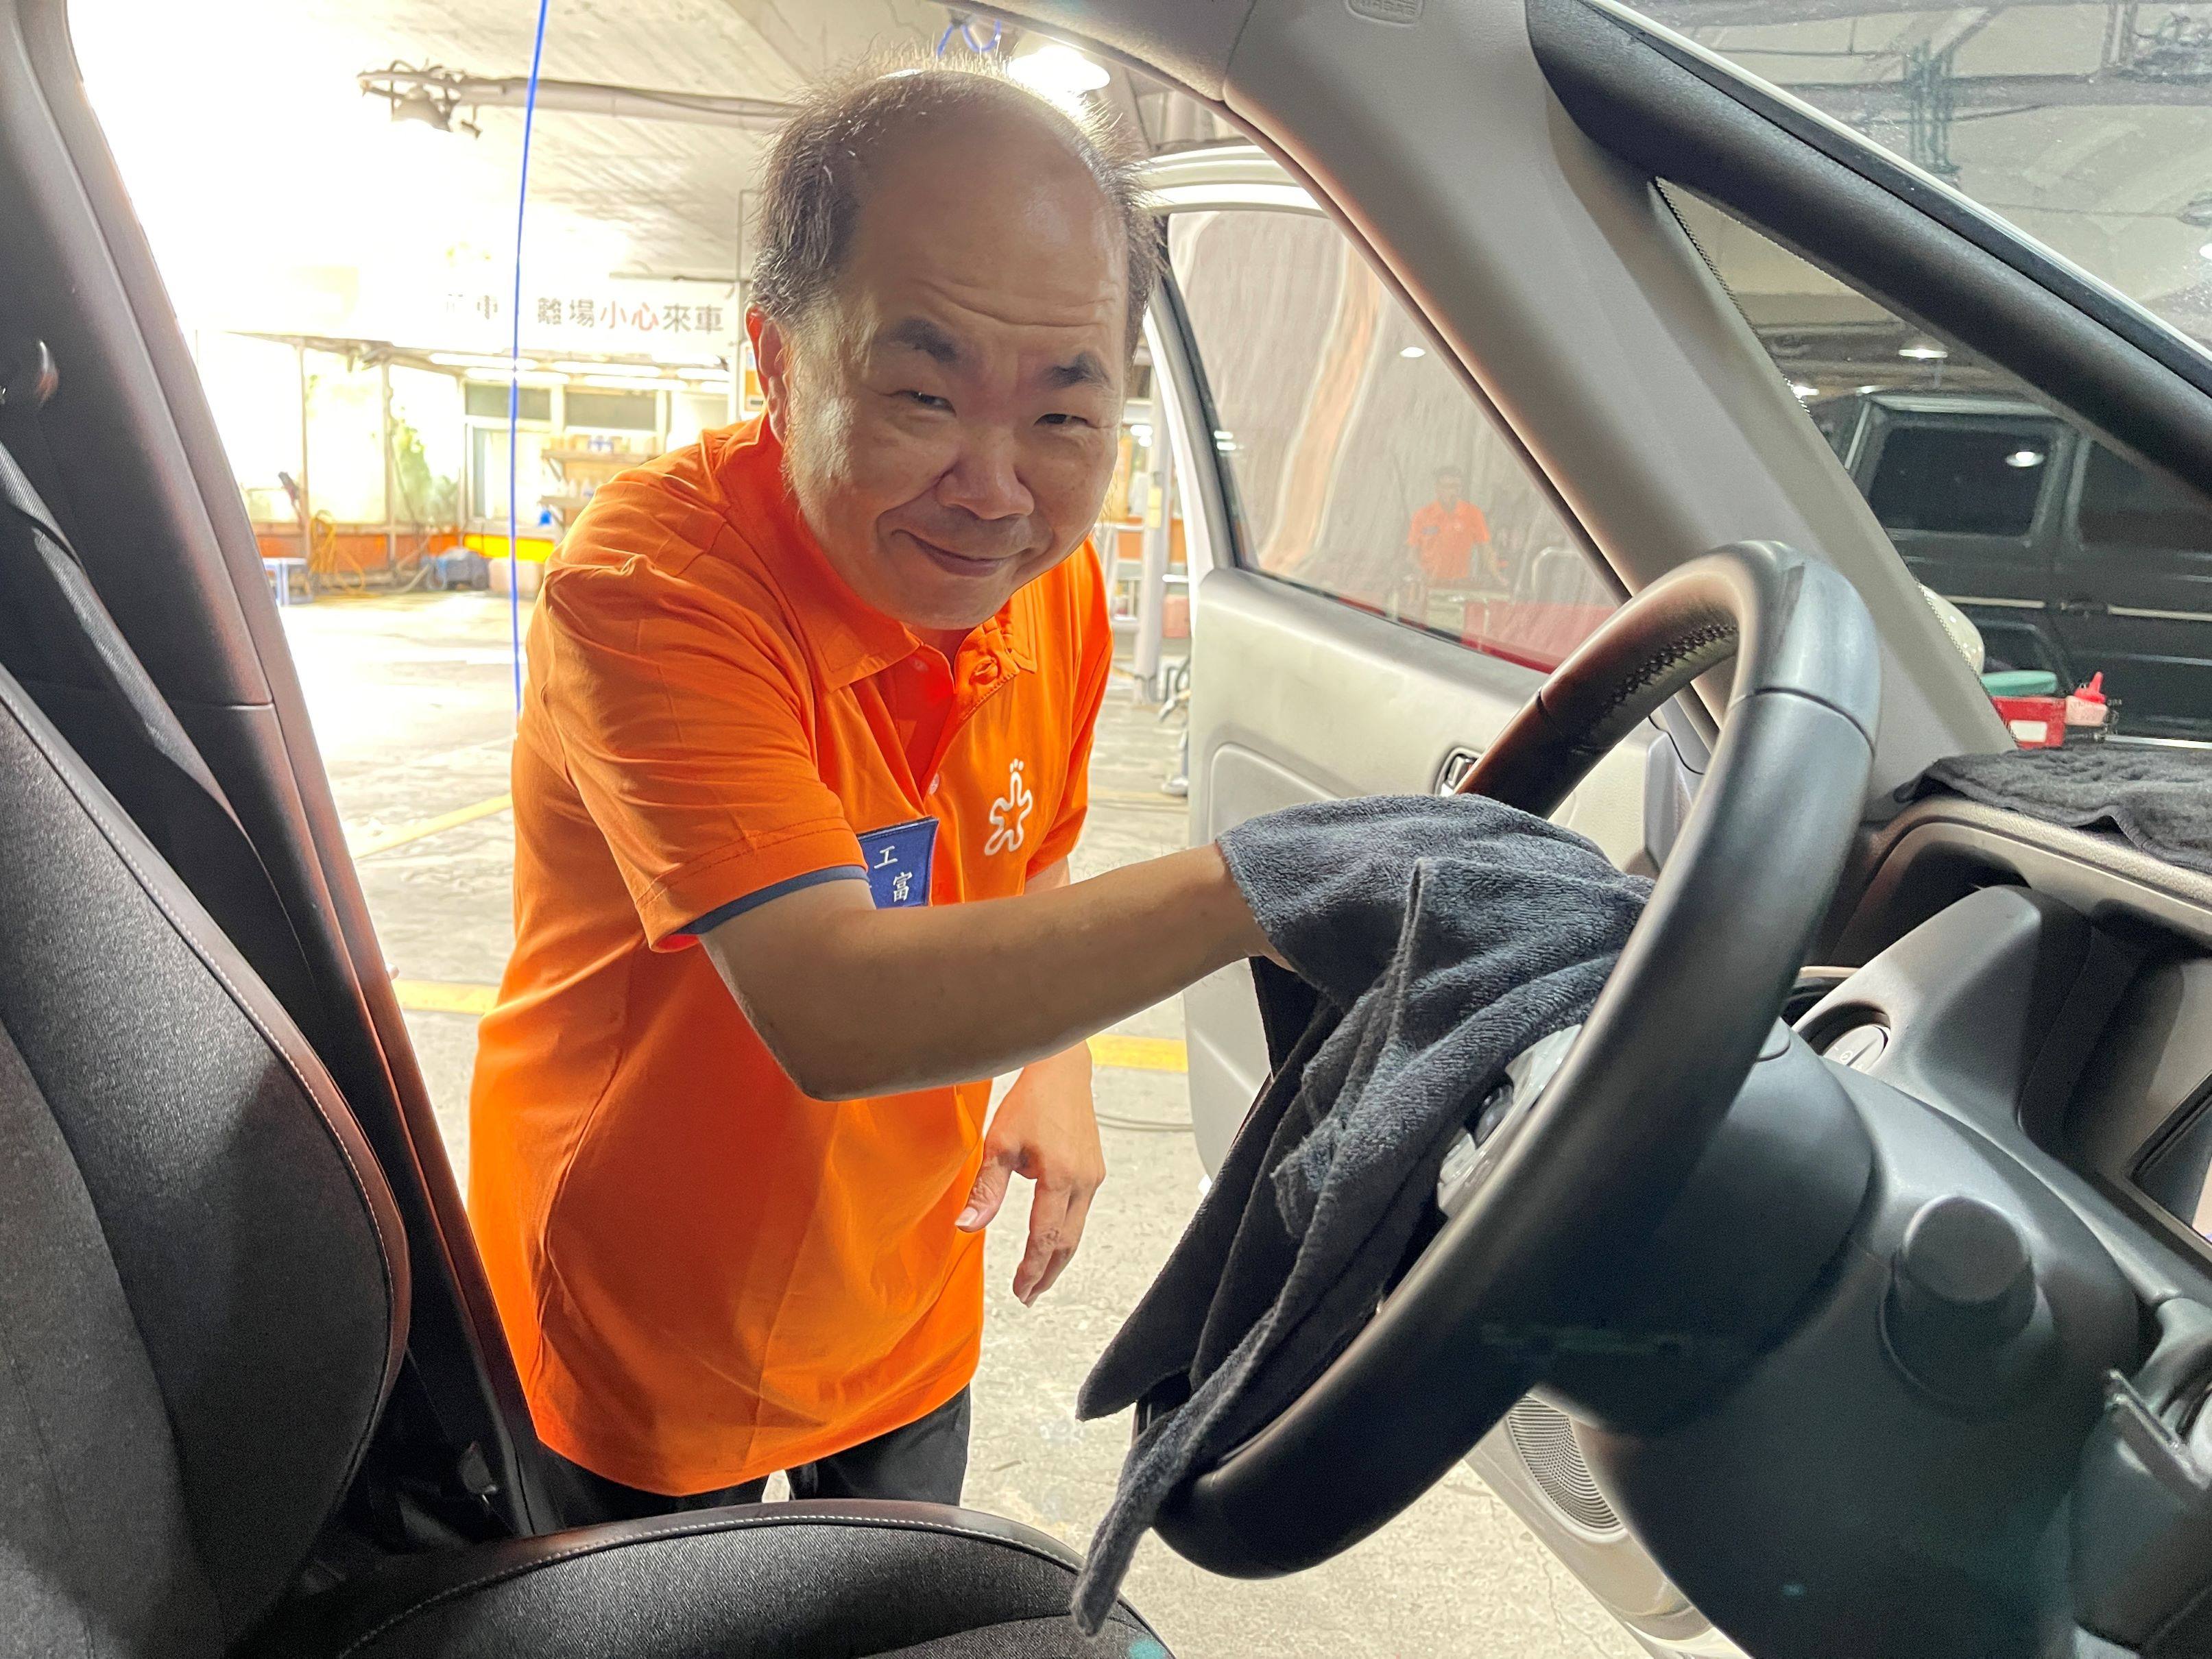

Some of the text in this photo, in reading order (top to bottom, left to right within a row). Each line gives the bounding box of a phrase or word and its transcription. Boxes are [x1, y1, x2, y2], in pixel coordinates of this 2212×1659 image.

[538, 297, 724, 335] 離場小心來車
